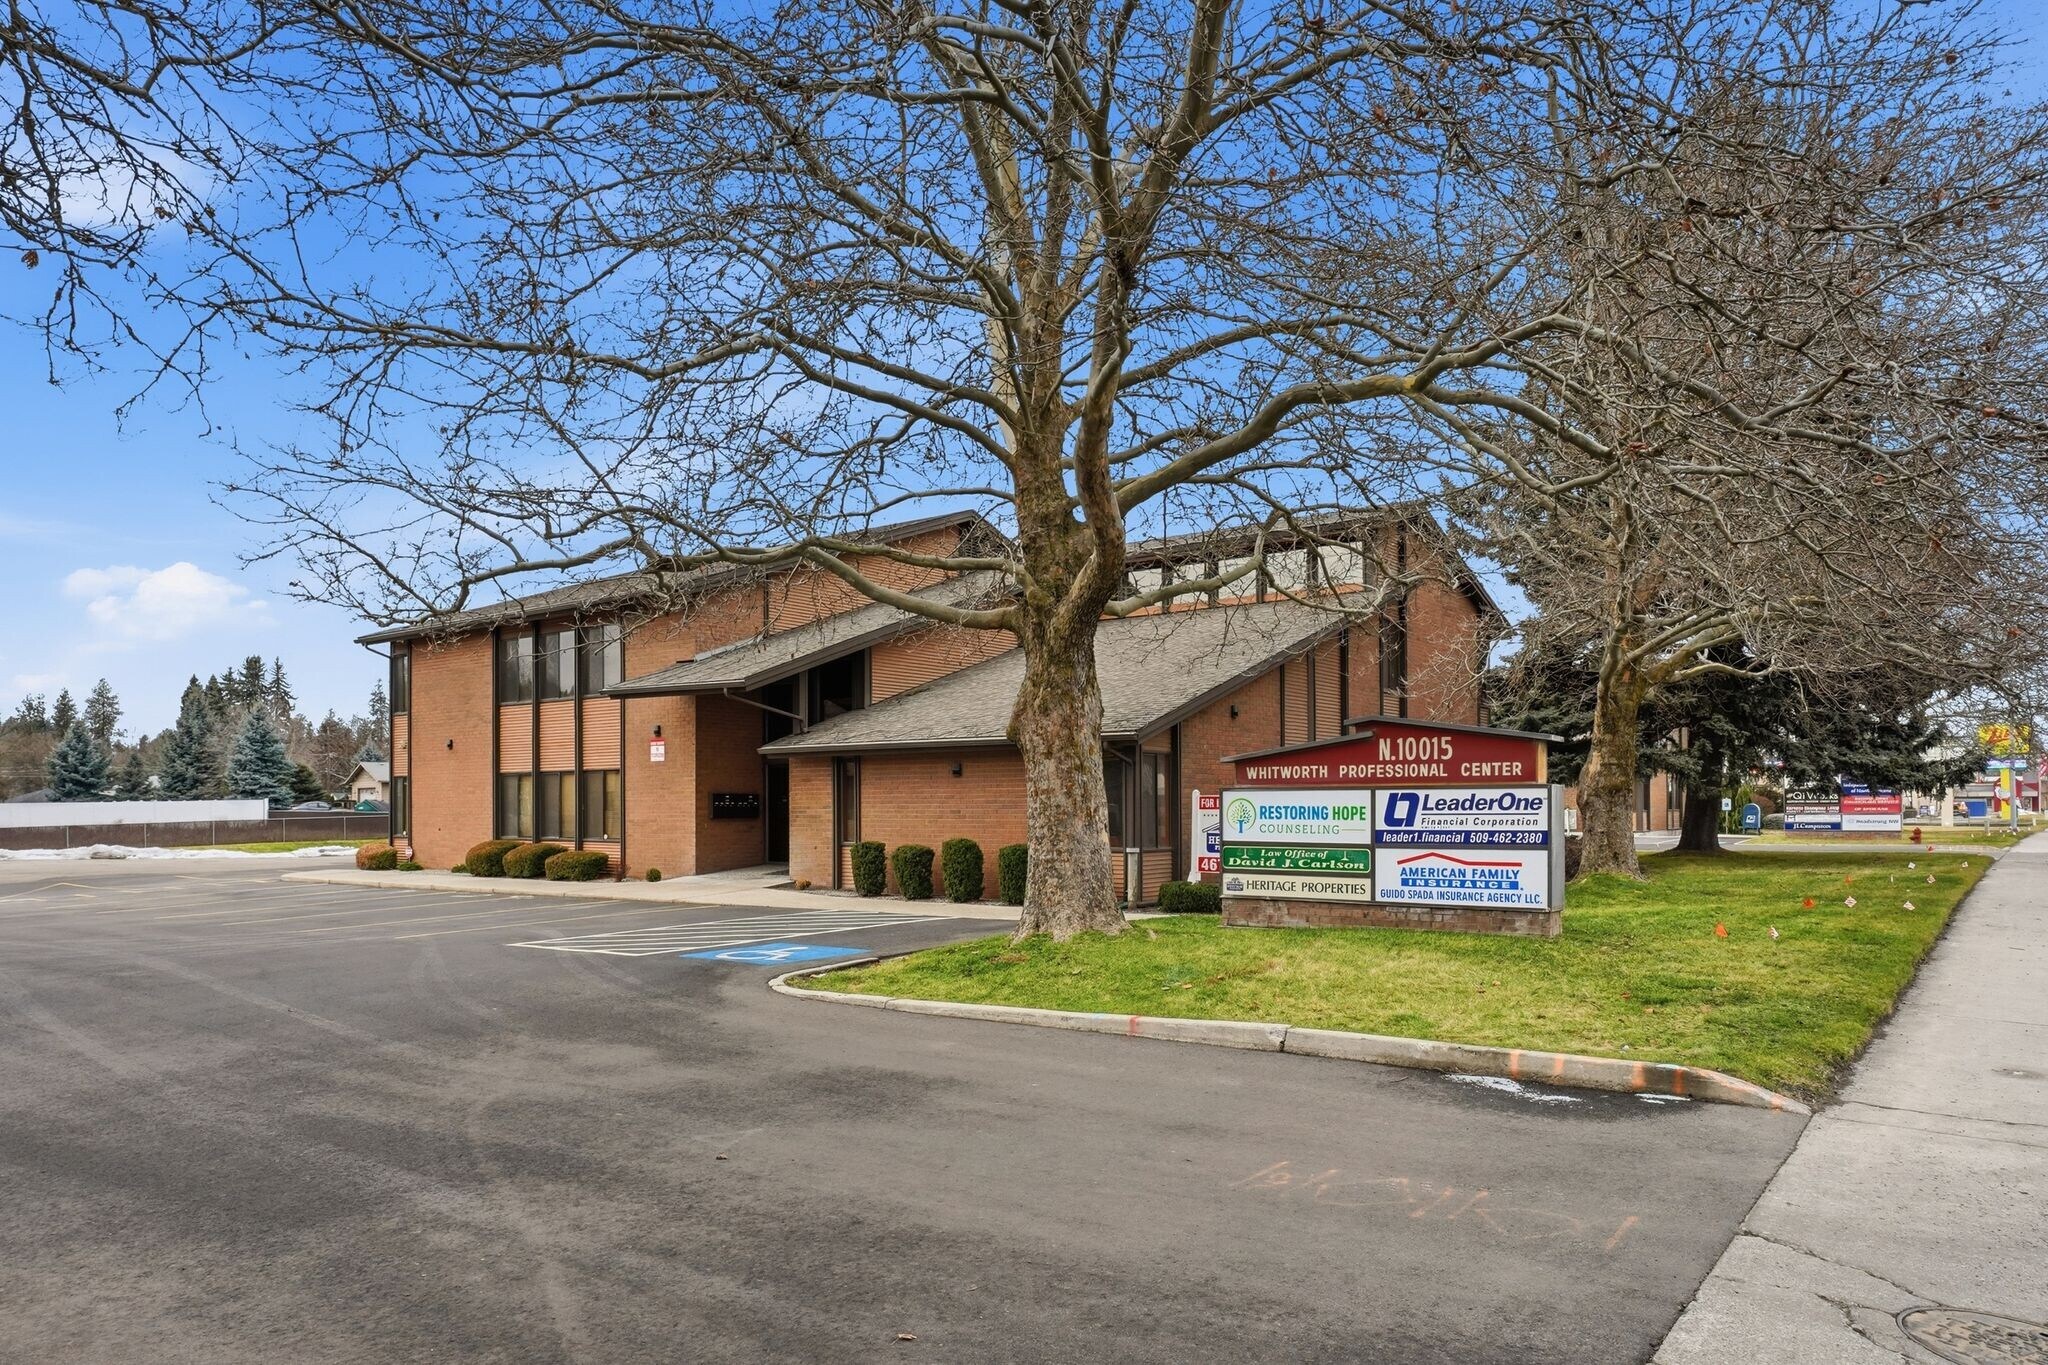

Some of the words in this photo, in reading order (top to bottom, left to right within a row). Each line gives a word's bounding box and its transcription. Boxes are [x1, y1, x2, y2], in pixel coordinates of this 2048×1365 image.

[1378, 736, 1453, 762] N.10015
[1246, 766, 1328, 780] WHITWORTH
[1340, 763, 1448, 778] PROFESSIONAL
[1460, 762, 1522, 776] CENTER
[1201, 798, 1214, 808] FOR
[1422, 792, 1544, 812] LeaderOne
[1260, 806, 1329, 820] RESTORING
[1332, 806, 1366, 821] HOPE
[1260, 824, 1340, 834] COUNSELING
[1421, 818, 1468, 826] Financial
[1473, 817, 1538, 828] Corporation
[1382, 832, 1465, 844] leader1.financial
[1470, 832, 1542, 844] 509-462-2380
[1284, 850, 1316, 858] Office
[1317, 851, 1328, 860] of
[1228, 857, 1276, 868] David
[1282, 858, 1294, 868] J.
[1298, 859, 1364, 870] Carlson
[1400, 867, 1467, 878] AMERICAN
[1472, 868, 1520, 880] FAMILY
[1246, 880, 1296, 892] HERITAGE
[1302, 882, 1366, 894] PROPERTIES
[1408, 880, 1510, 889] INSURANCE
[1380, 888, 1405, 899] GUIDO
[1408, 890, 1434, 900] SPADA
[1436, 890, 1484, 902] INSURANCE
[1488, 892, 1522, 904] AGENCY
[1525, 894, 1542, 904] LLC.
